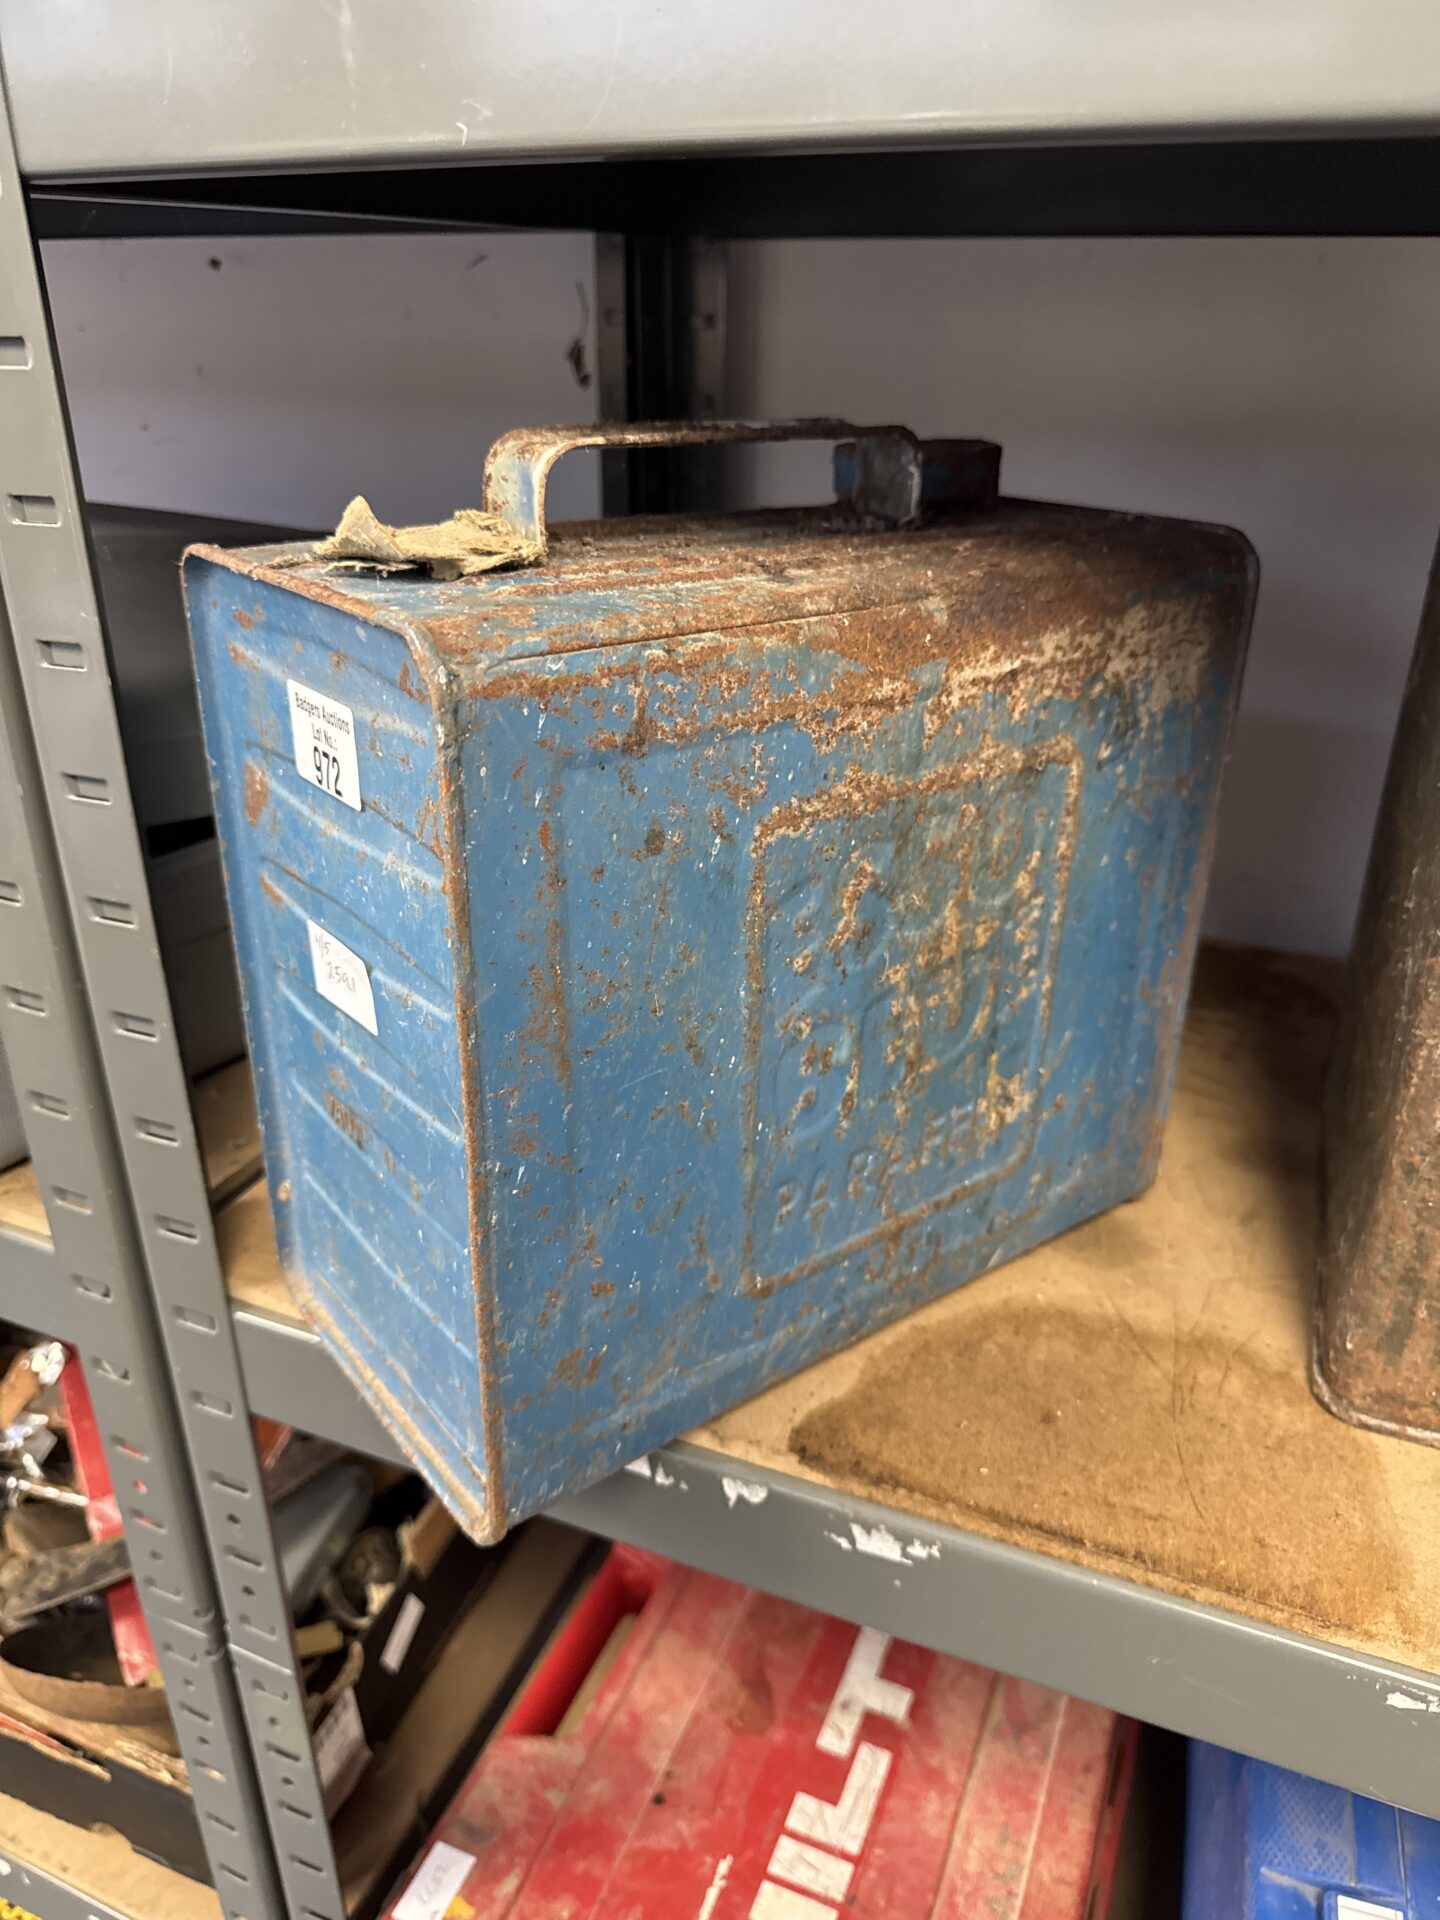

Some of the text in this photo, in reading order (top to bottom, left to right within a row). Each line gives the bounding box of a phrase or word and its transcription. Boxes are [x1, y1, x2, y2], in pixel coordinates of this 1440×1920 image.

[294, 692, 350, 735] Badgers Auctions
[312, 723, 322, 745] Lot
[313, 745, 343, 797] 972
